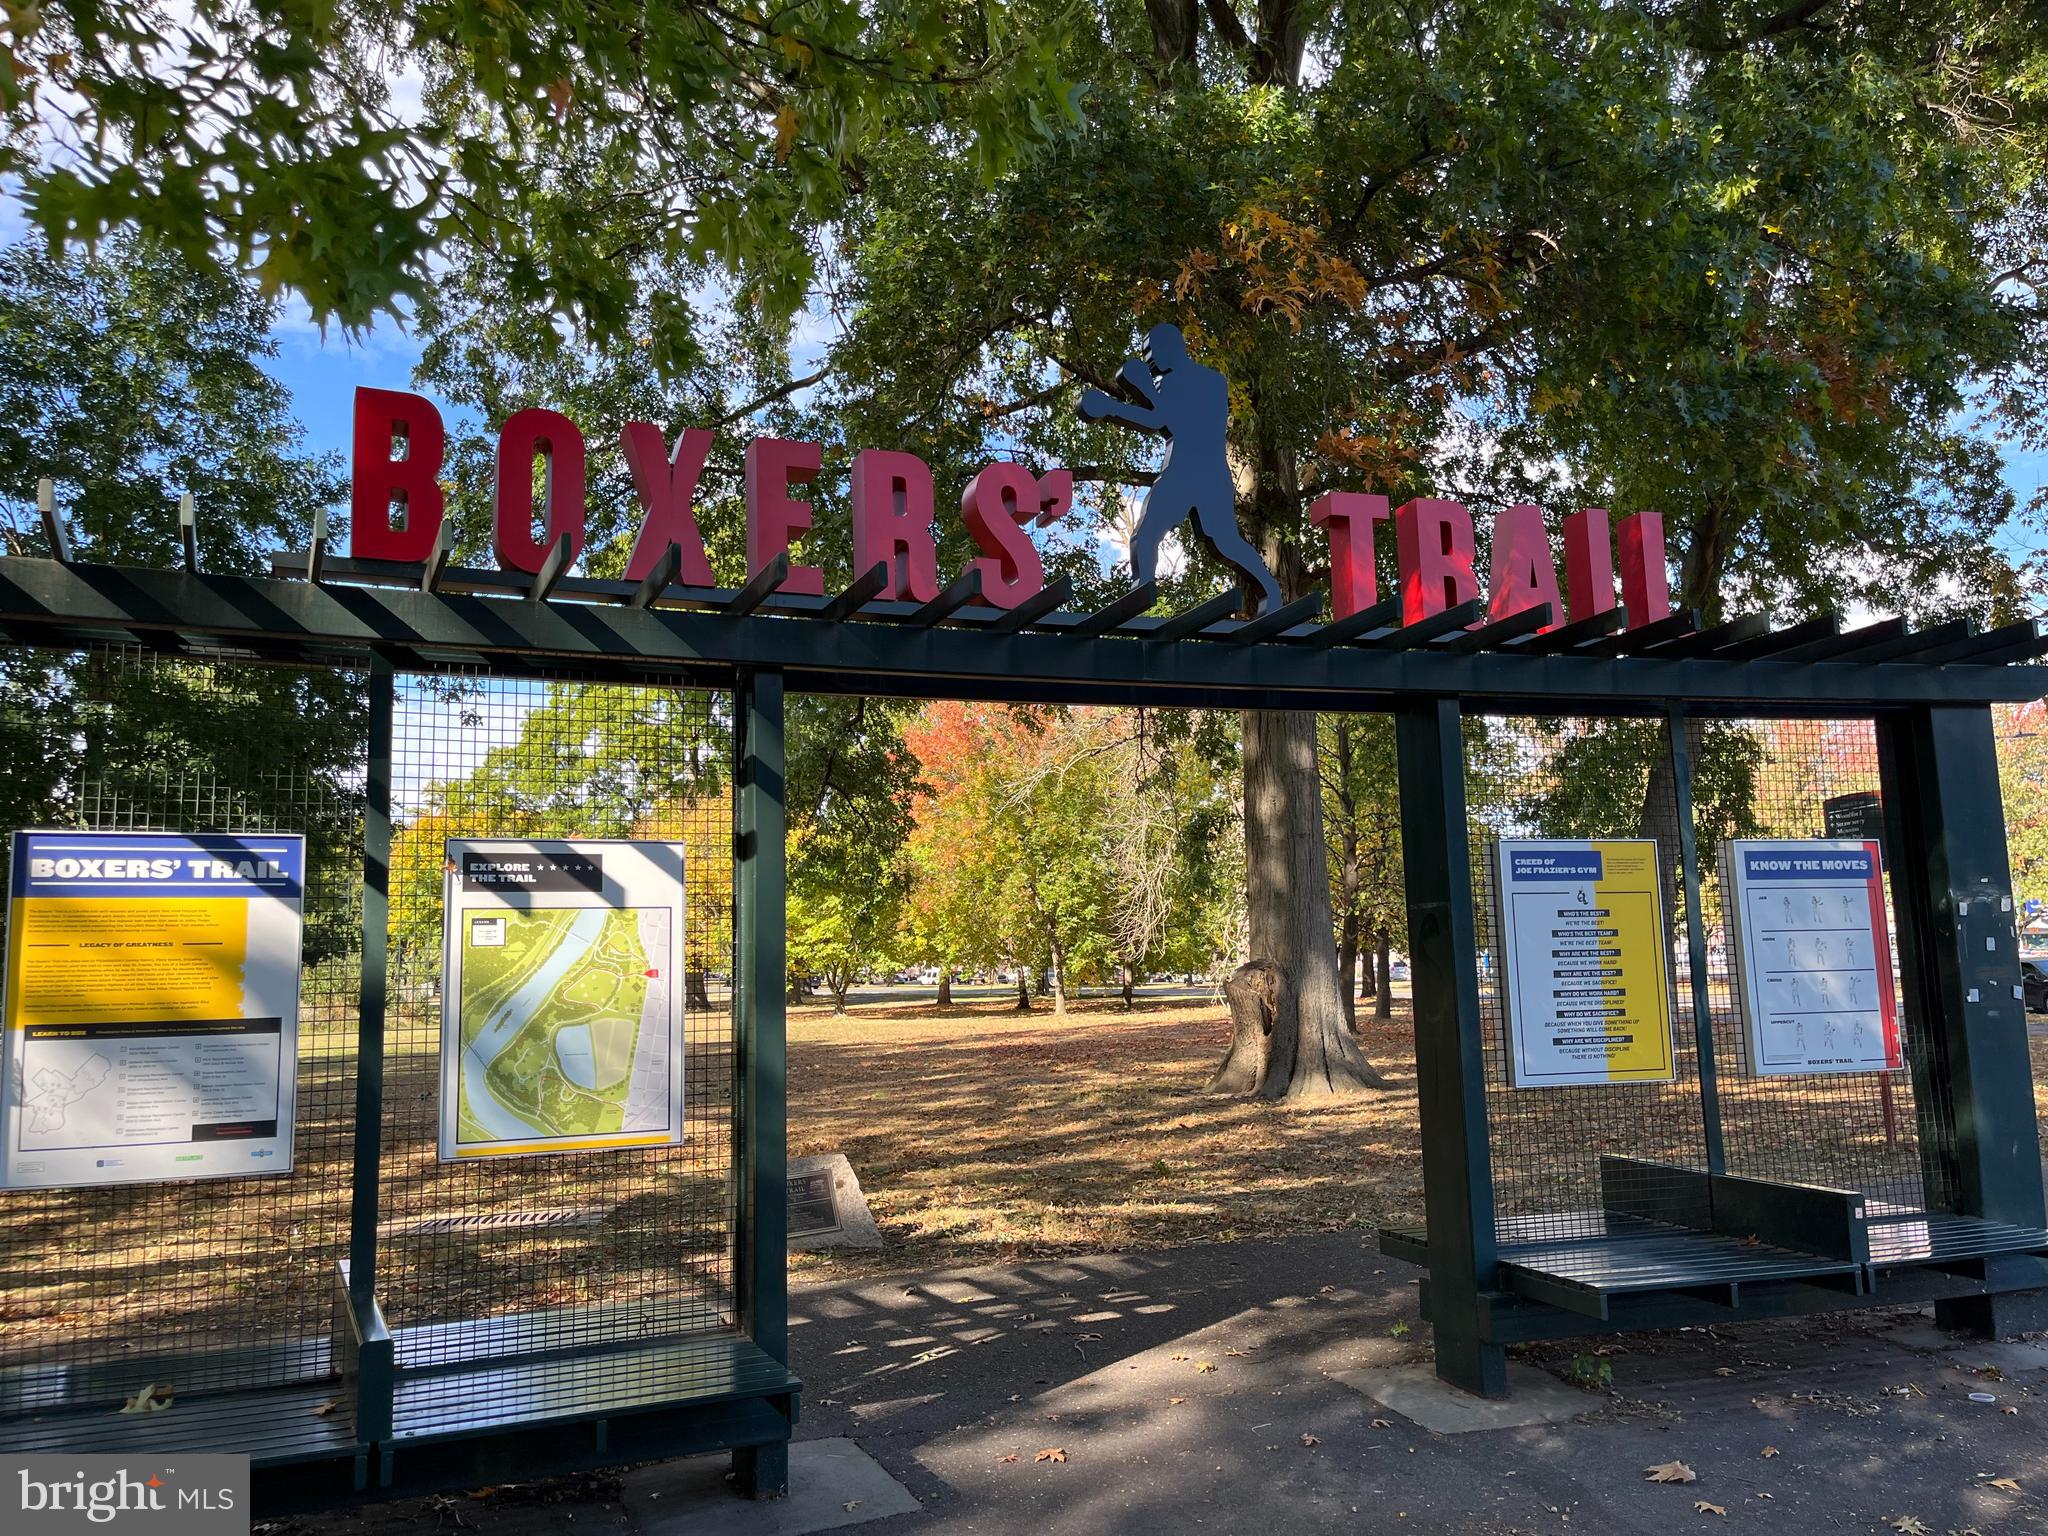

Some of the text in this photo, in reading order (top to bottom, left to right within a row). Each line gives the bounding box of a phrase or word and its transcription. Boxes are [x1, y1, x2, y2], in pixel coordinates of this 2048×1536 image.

[1310, 491, 1671, 632] TRAIL
[188, 860, 288, 878] TRAIL
[470, 863, 530, 872] EXPLORE
[1750, 860, 1868, 871] KNOW THE MOVES
[470, 874, 536, 882] THE TRAIL
